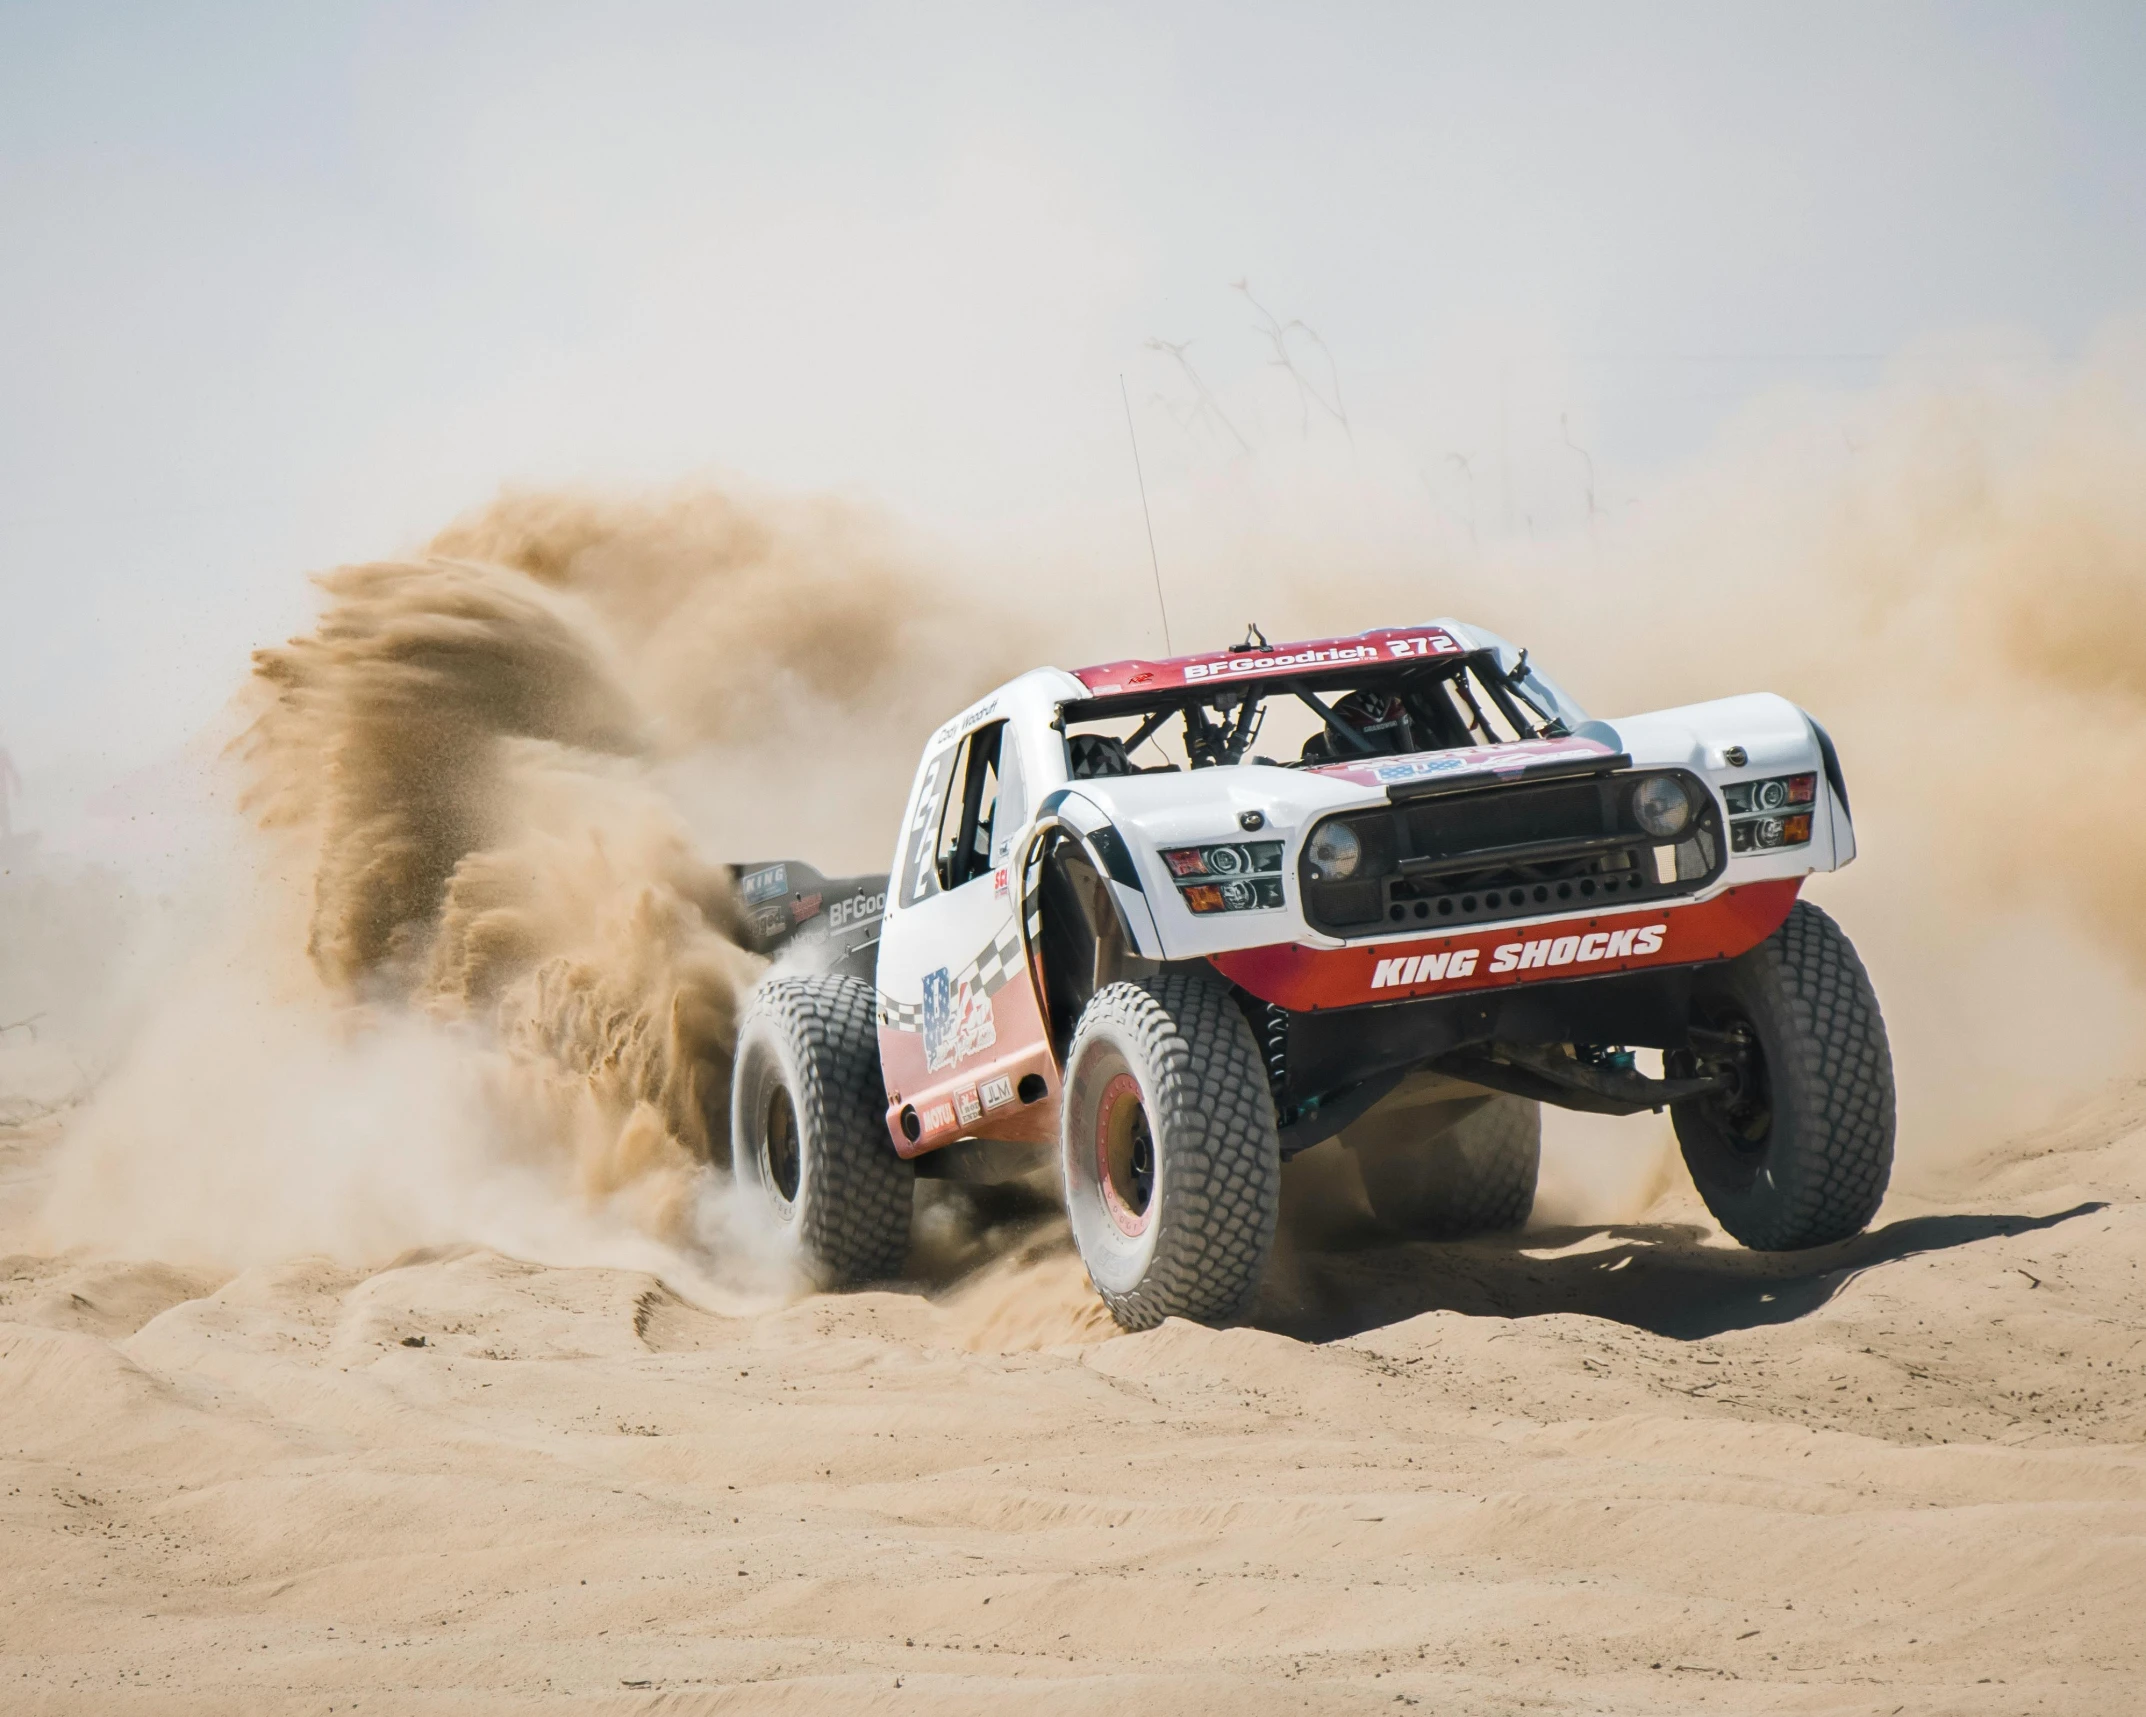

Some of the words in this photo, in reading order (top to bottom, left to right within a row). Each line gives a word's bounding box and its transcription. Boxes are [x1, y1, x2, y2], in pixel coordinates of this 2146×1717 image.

[1385, 636, 1458, 658] 272
[1184, 645, 1378, 680] BFGoodrich
[937, 723, 959, 744] Cody
[746, 868, 784, 893] KING
[1371, 949, 1480, 989] KING
[1489, 924, 1667, 973] SHOCKS
[988, 1081, 1011, 1104] JLM
